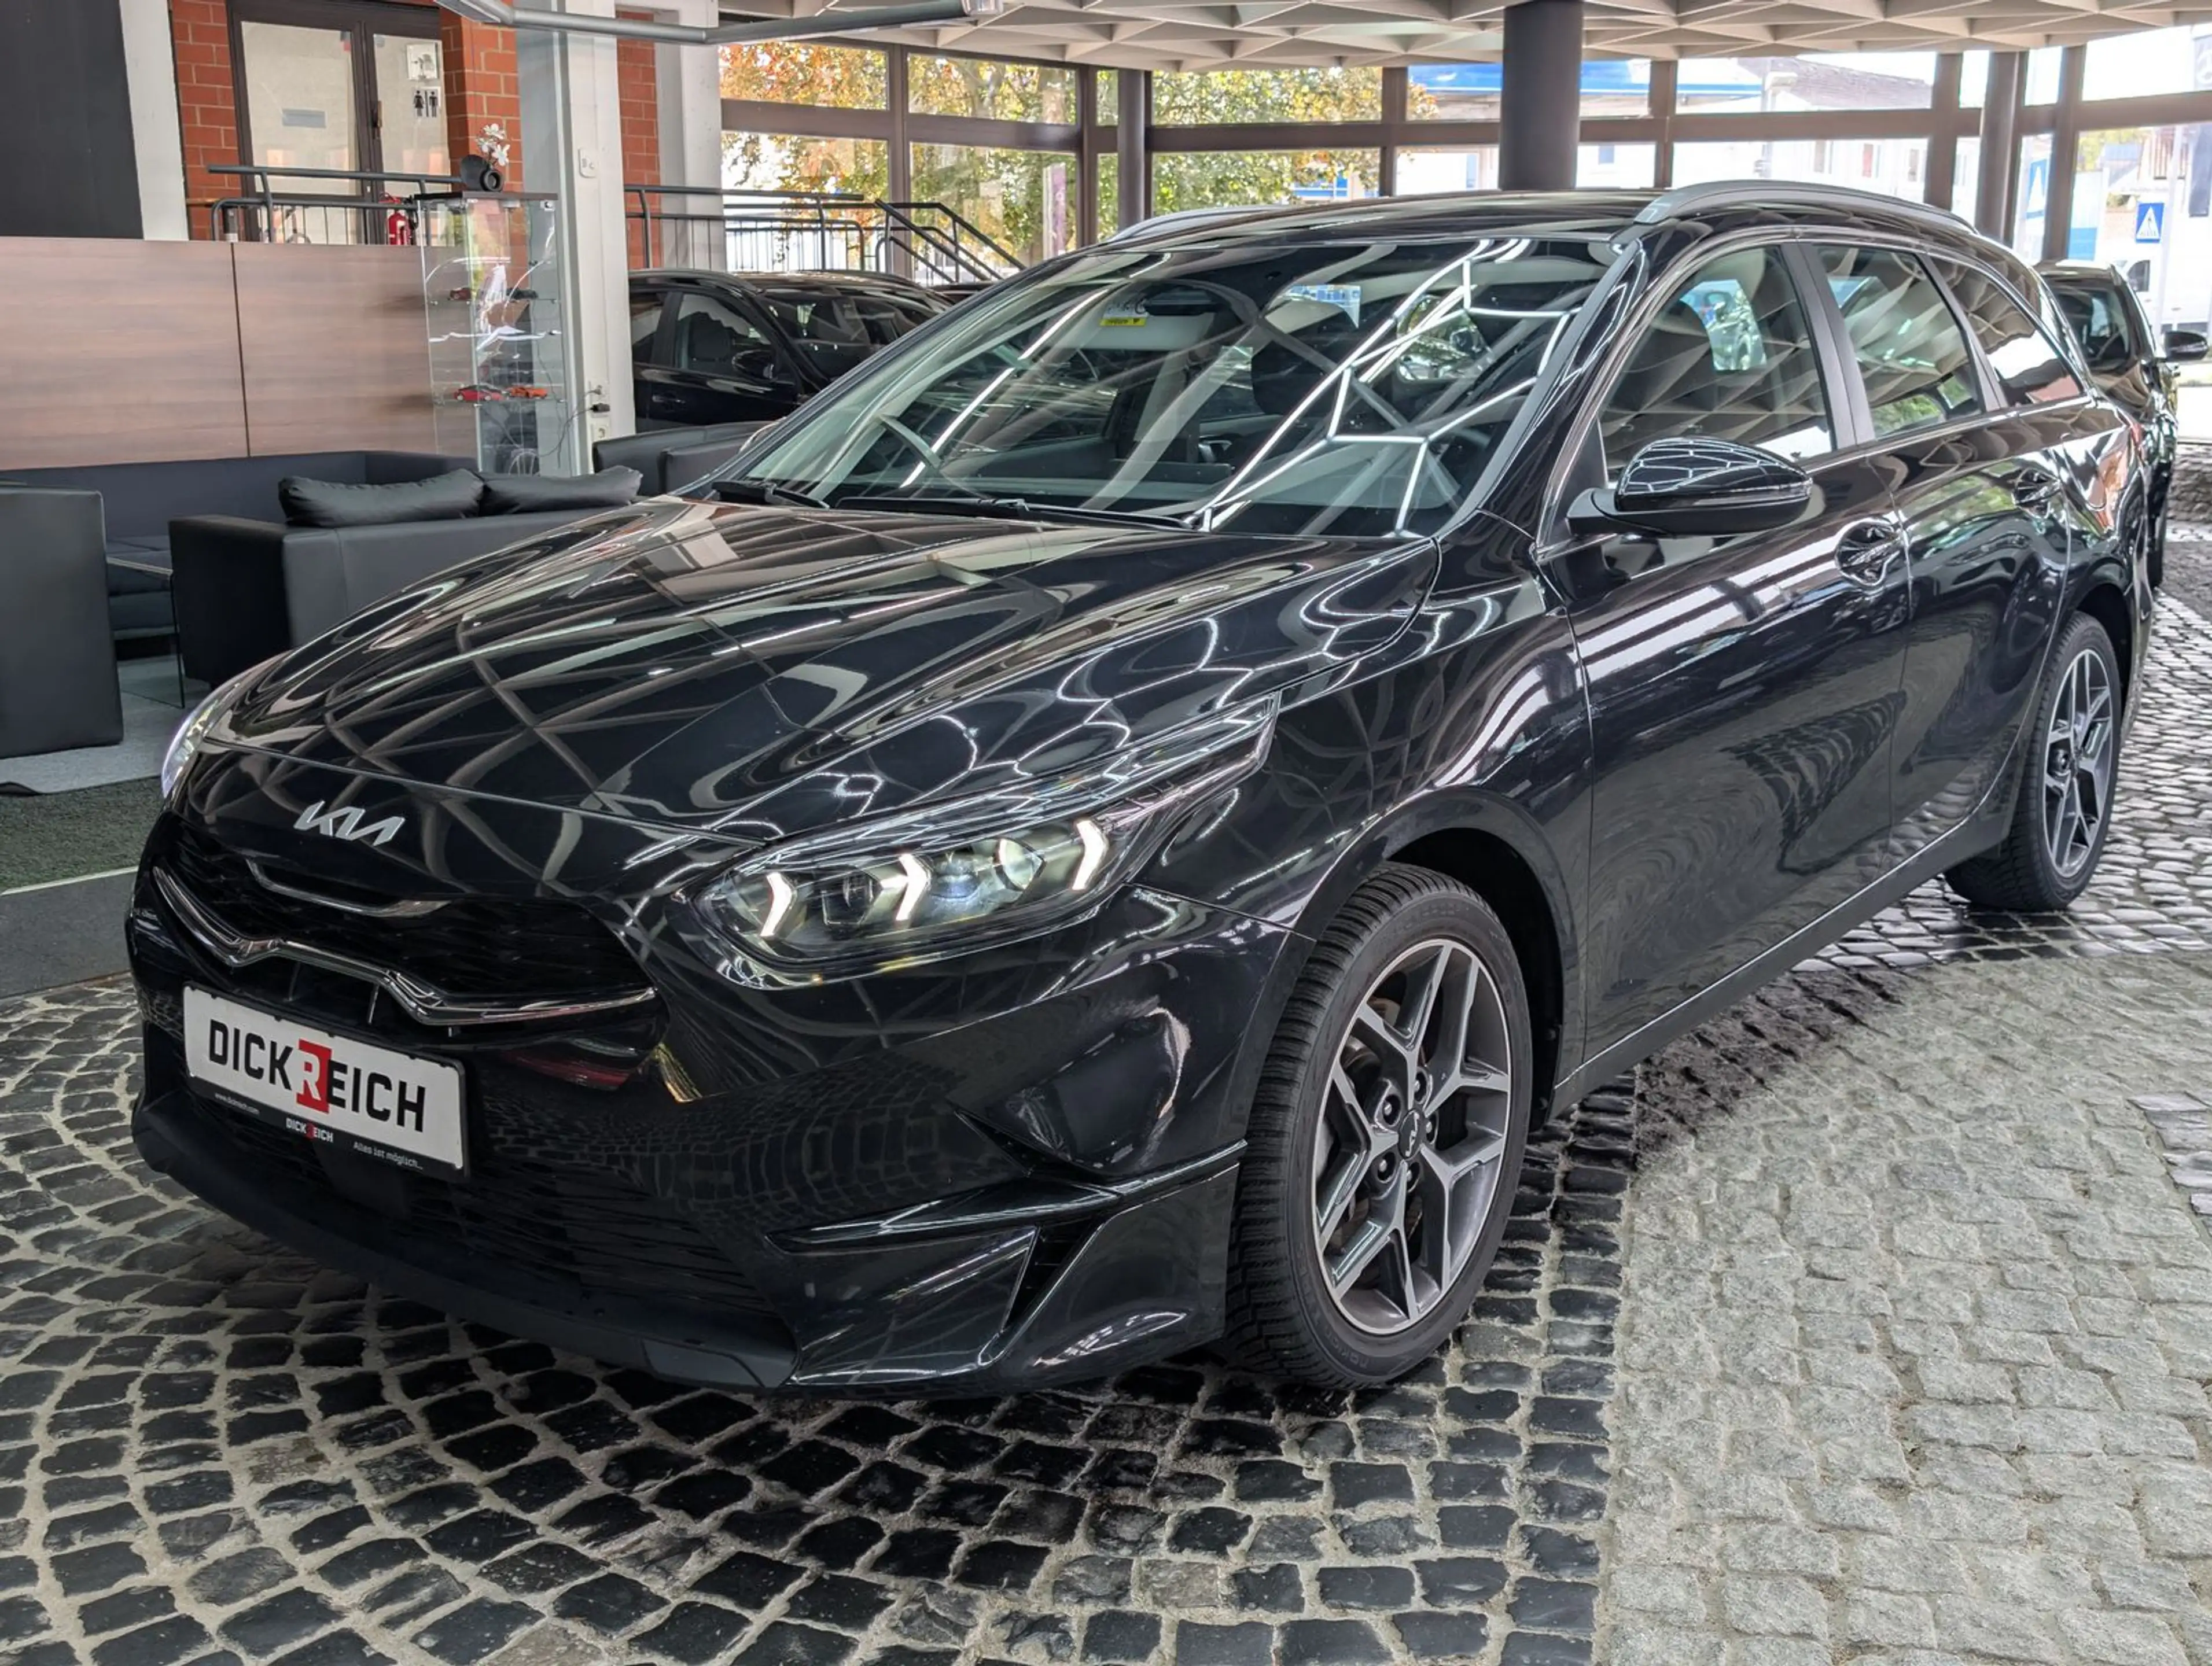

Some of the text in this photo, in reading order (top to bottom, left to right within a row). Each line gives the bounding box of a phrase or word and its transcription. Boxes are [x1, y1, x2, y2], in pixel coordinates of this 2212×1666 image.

[293, 800, 405, 846] KIA
[209, 1019, 426, 1133] DICKREICH
[286, 1117, 333, 1143] DICKEICH
